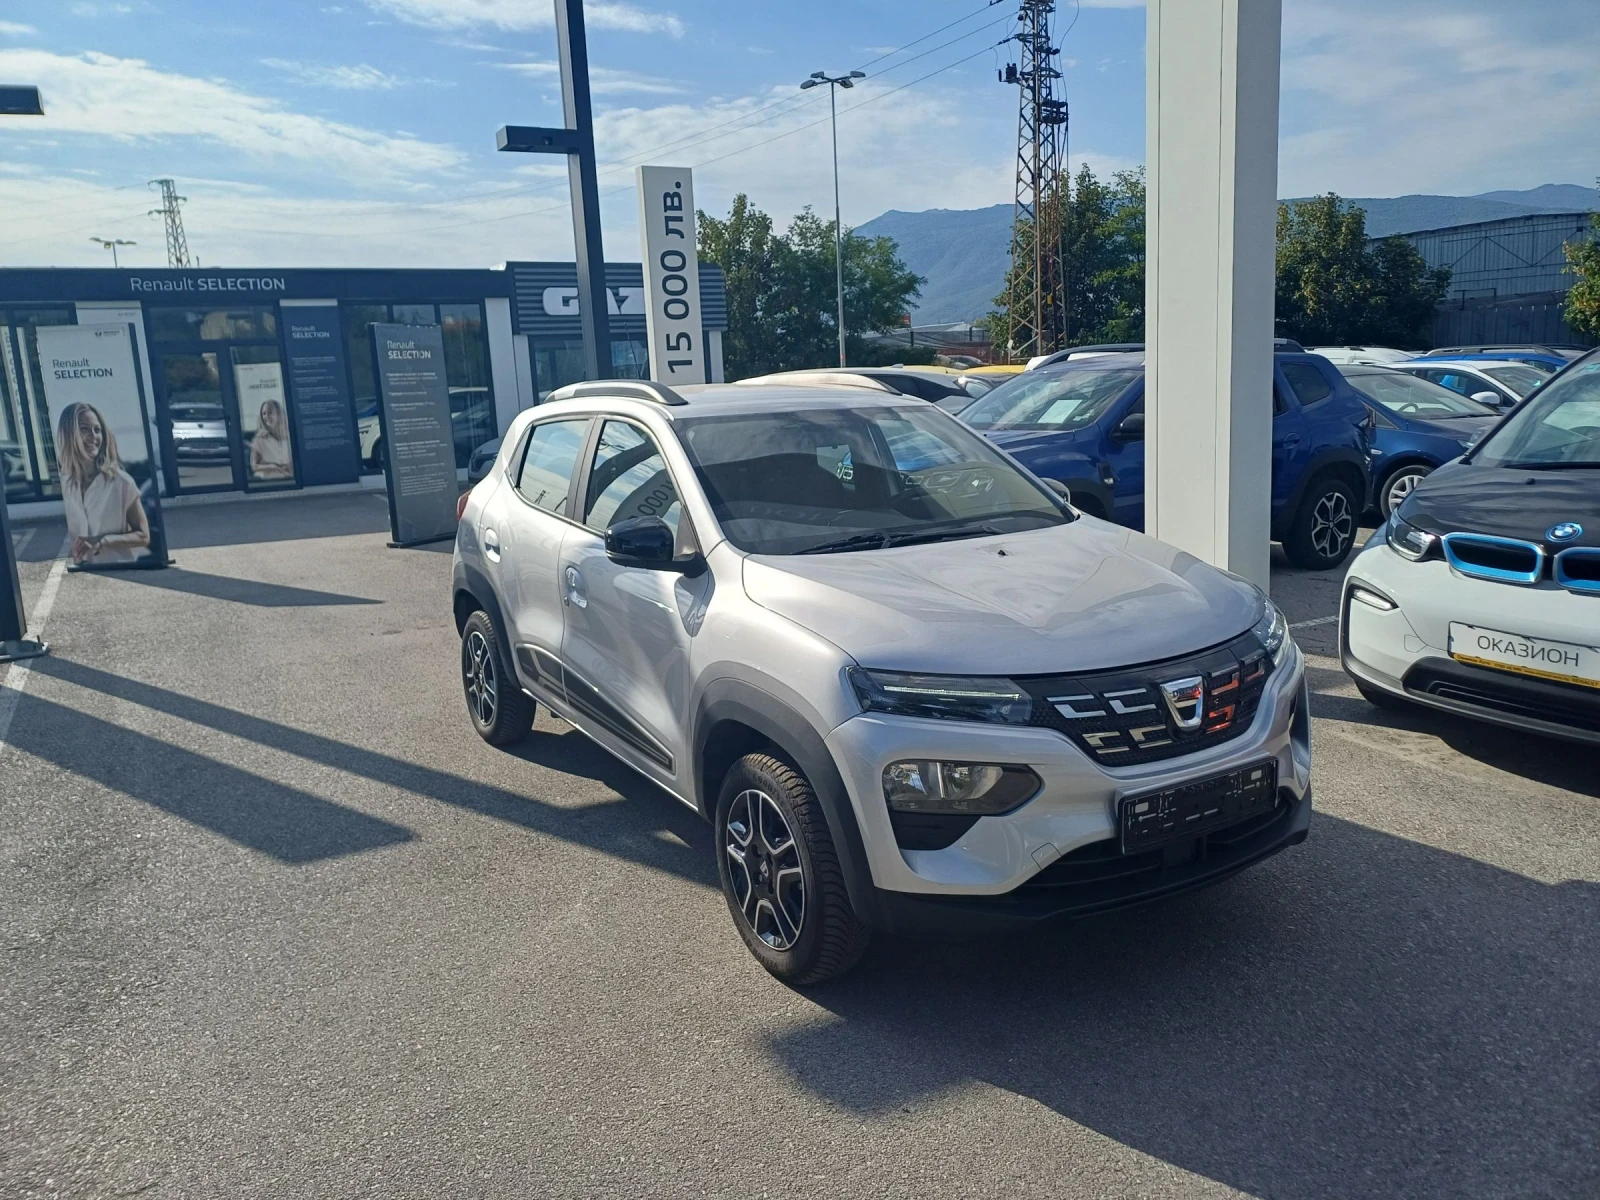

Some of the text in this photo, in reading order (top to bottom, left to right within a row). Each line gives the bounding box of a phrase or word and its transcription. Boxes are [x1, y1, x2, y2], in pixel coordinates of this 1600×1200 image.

[660, 180, 692, 374] 15 000 лв.
[130, 276, 286, 291] Renault SELECTION
[386, 339, 415, 349] Renault
[387, 350, 431, 359] SELECTION
[52, 357, 90, 368] Renault
[54, 368, 113, 379] SELECTION
[1477, 635, 1579, 667] ОКАЗИОН
